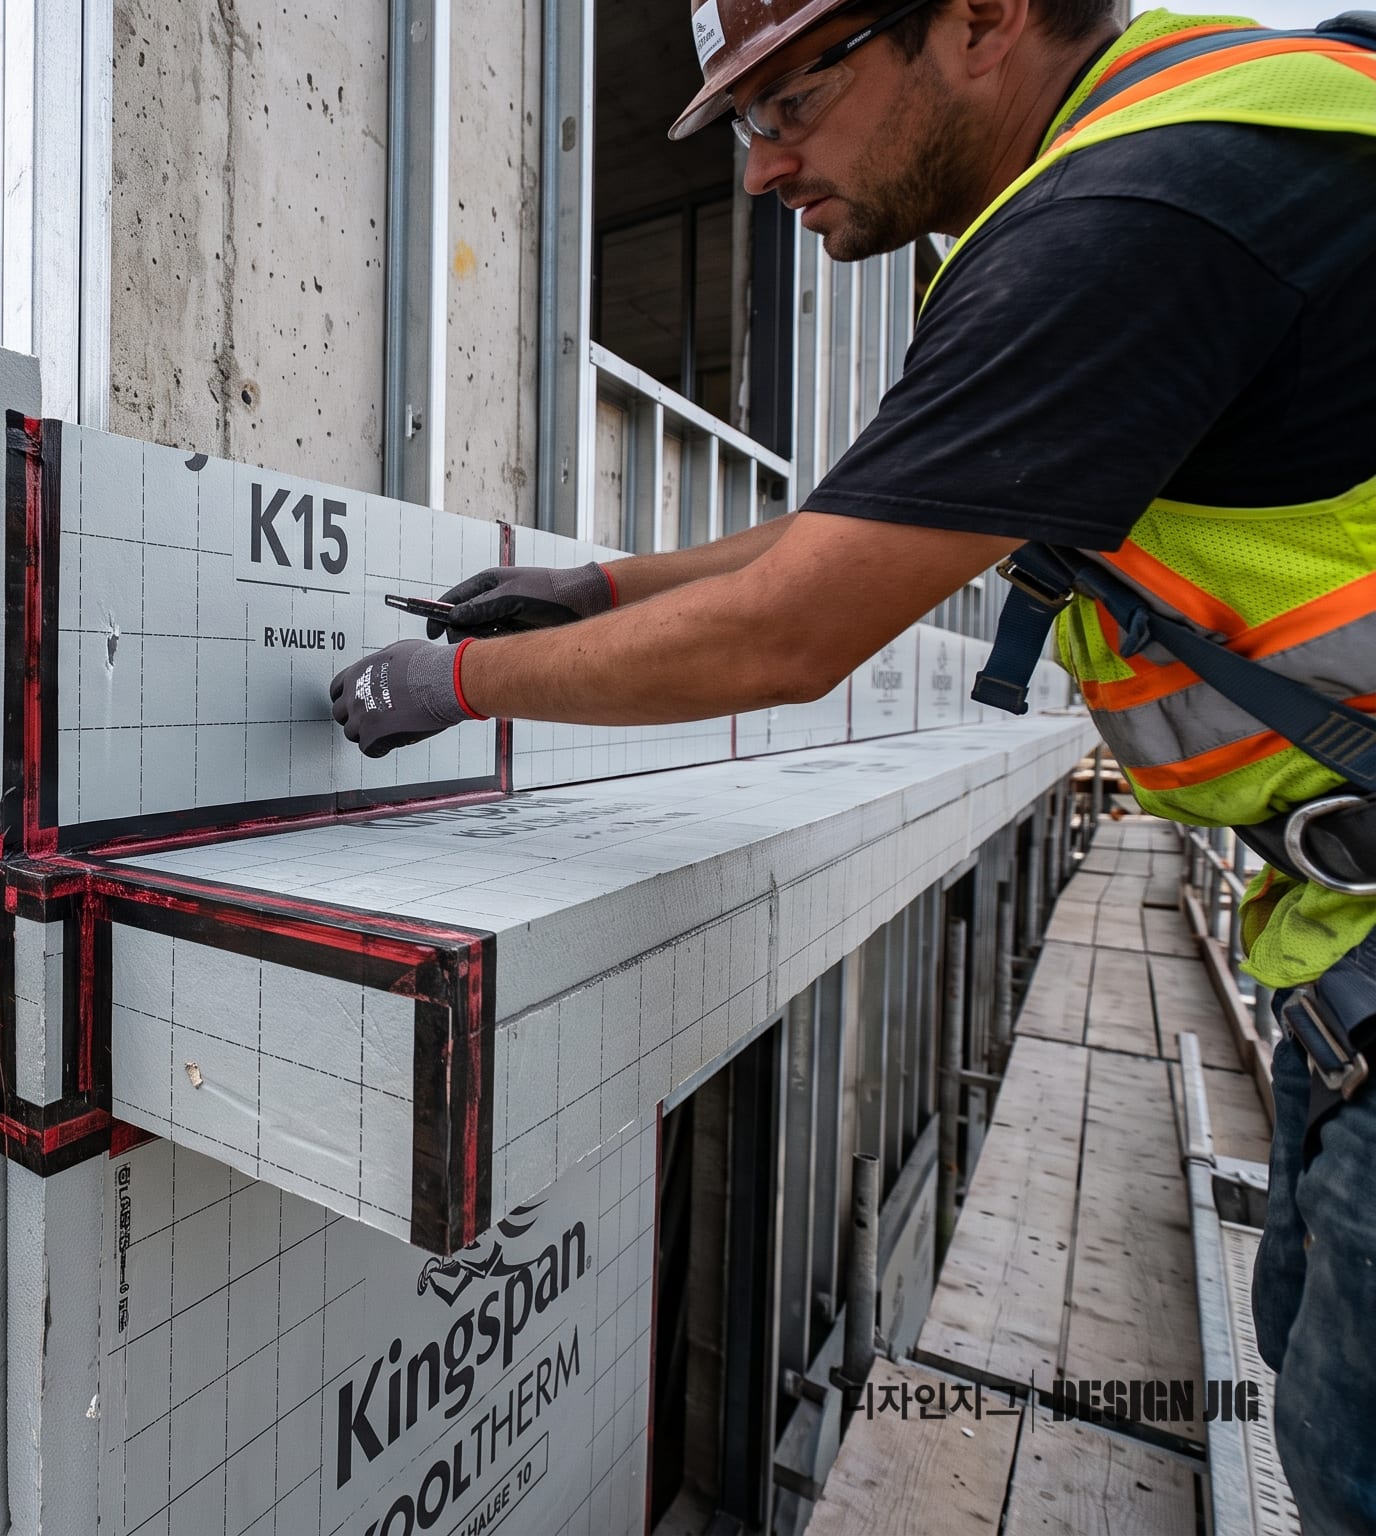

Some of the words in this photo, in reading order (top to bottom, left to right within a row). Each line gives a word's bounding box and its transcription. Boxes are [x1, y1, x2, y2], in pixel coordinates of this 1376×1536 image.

[250, 482, 349, 575] K15
[330, 631, 346, 651] 10
[516, 1461, 532, 1491] 10
